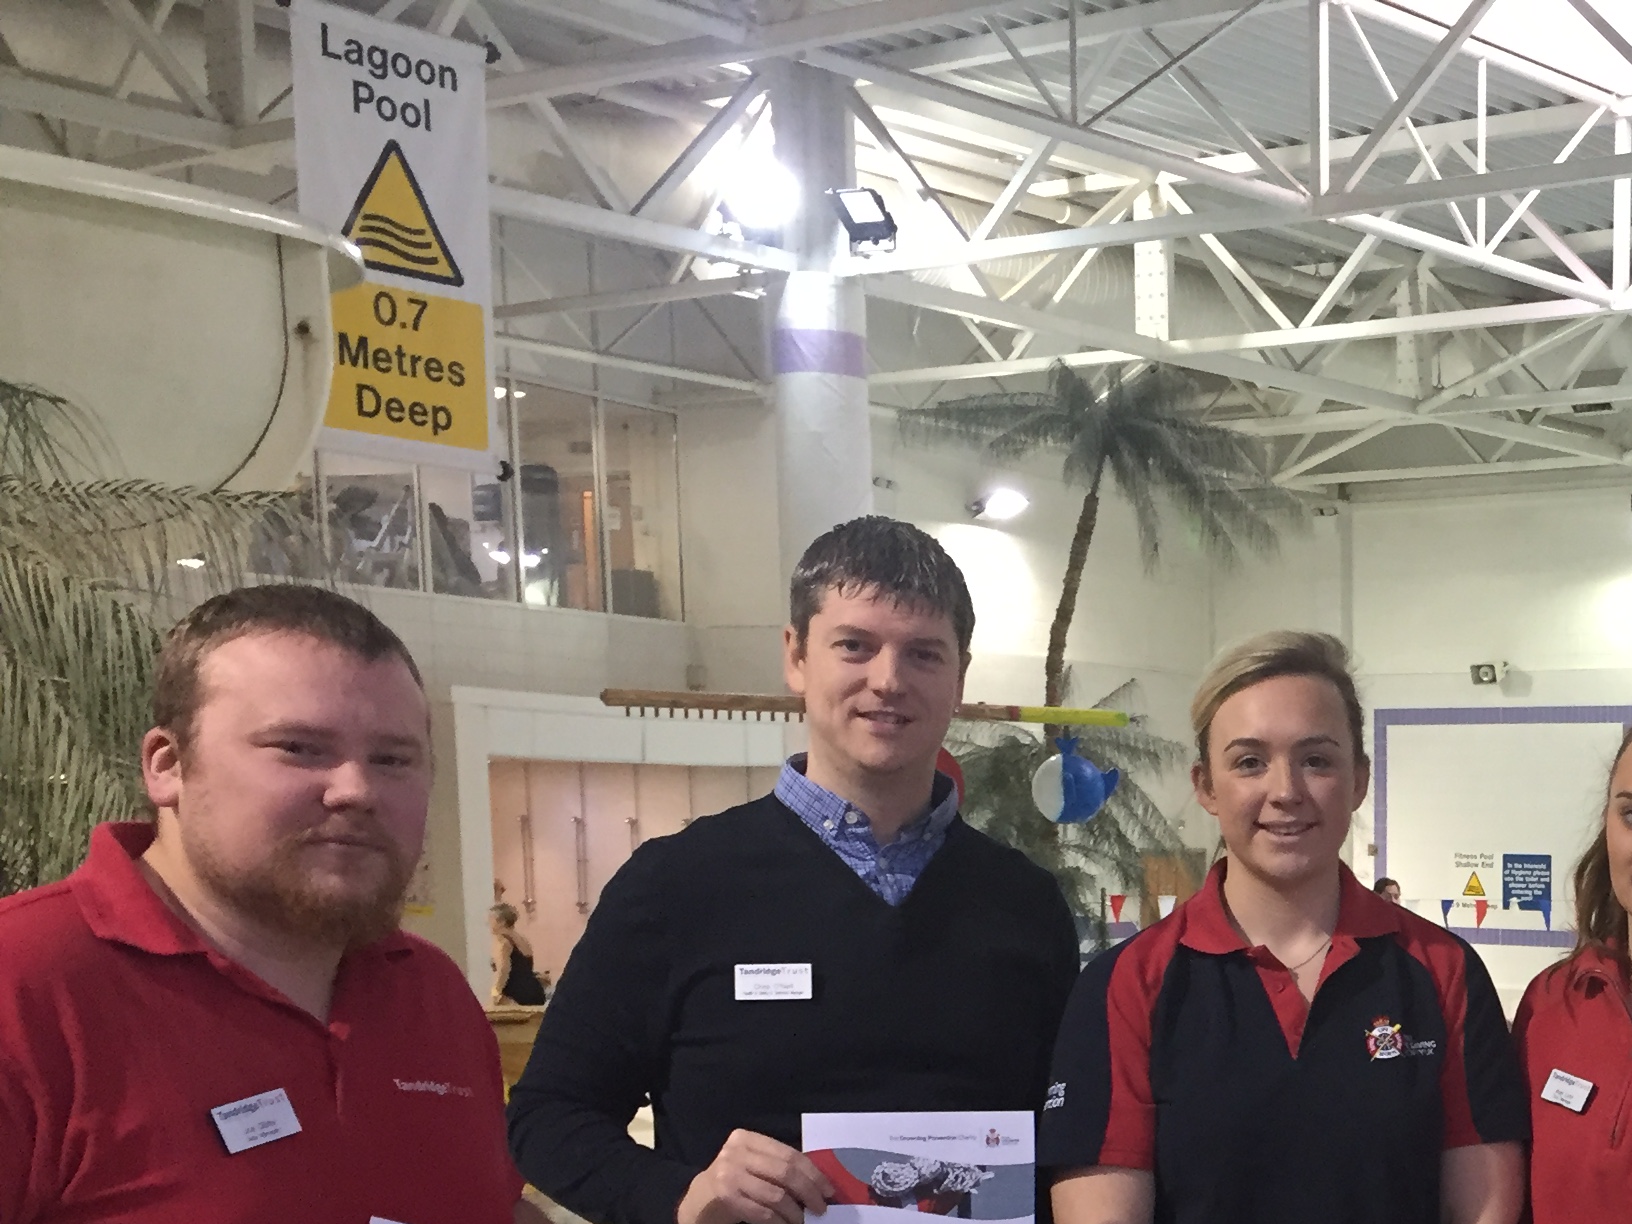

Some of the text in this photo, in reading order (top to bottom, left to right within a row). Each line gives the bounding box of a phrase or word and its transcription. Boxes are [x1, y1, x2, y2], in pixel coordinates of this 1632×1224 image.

[321, 22, 457, 91] Lagoon
[352, 80, 432, 131] Pool
[373, 292, 427, 331] 0.7
[338, 332, 465, 387] Metres
[356, 384, 452, 436] Deep
